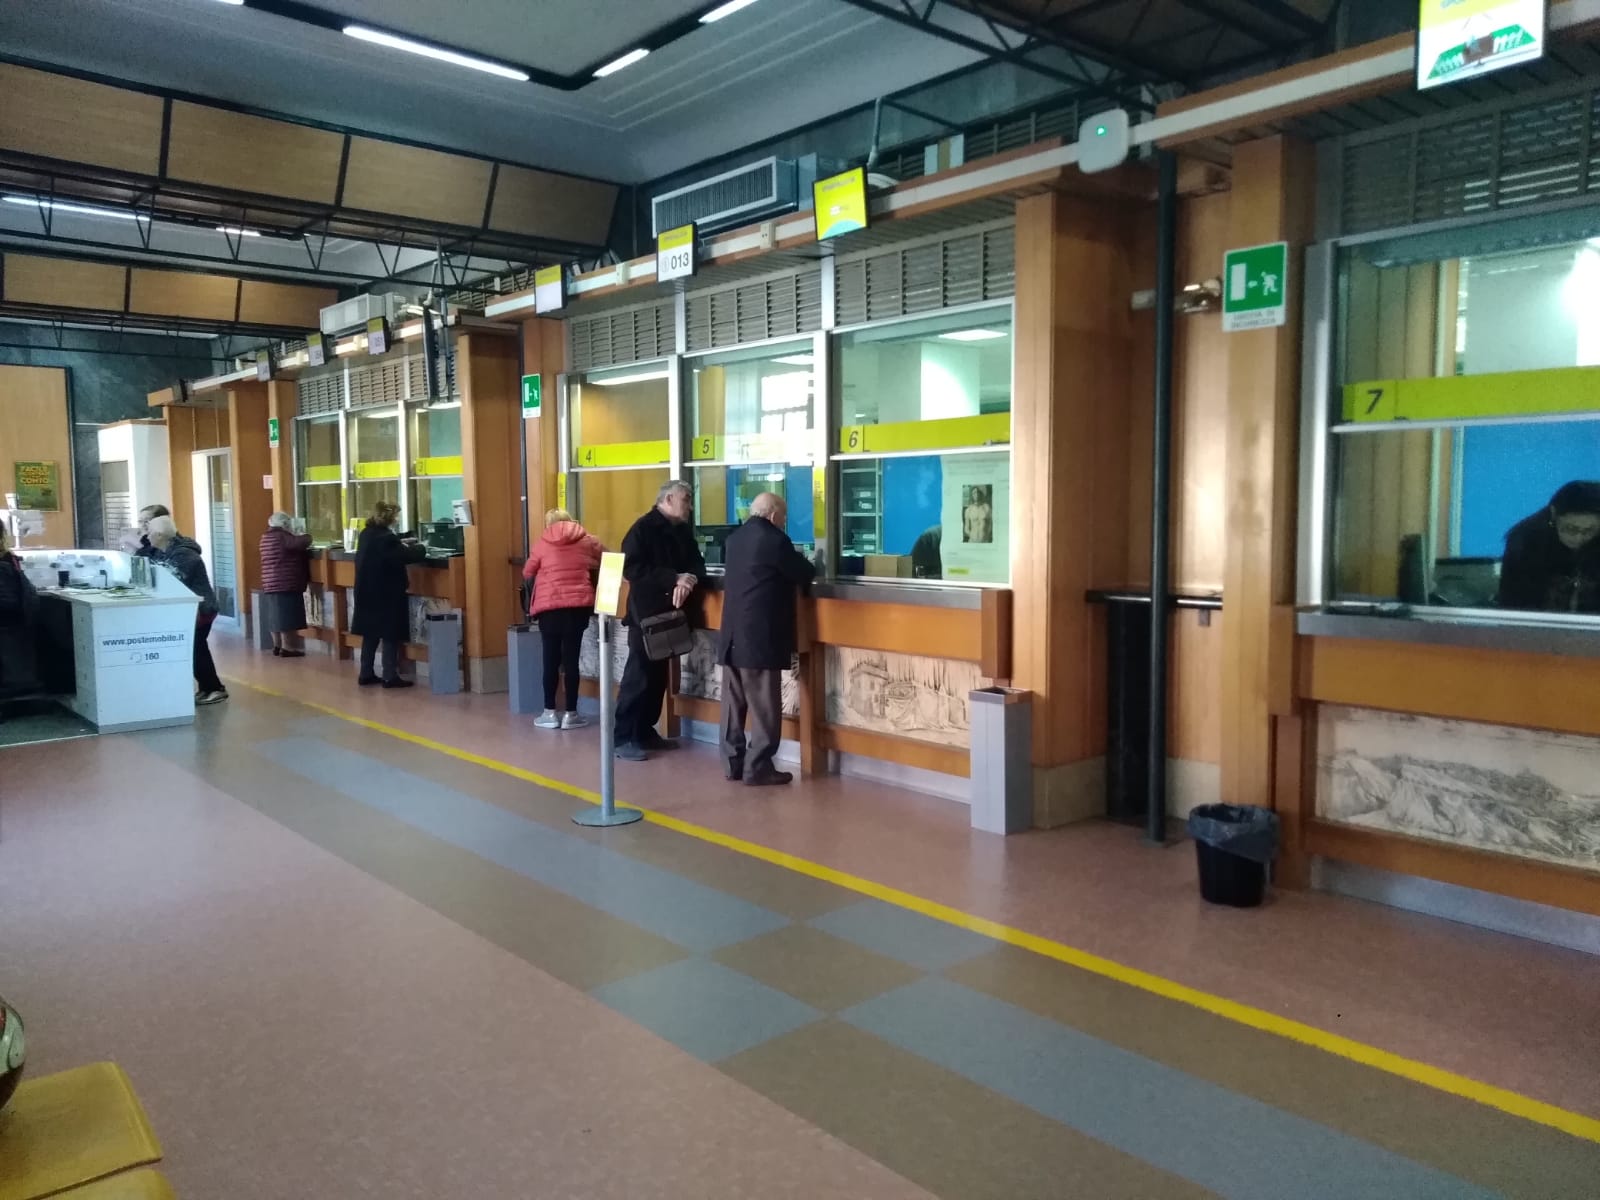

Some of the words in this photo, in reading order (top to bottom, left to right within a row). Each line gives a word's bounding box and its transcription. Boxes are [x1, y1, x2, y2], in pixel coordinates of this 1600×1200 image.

[671, 252, 689, 270] 013
[1365, 388, 1384, 415] 7
[702, 439, 710, 454] 5
[849, 430, 859, 448] 6
[585, 449, 592, 463] 4
[102, 633, 184, 646] www.postemobile.it
[145, 652, 159, 661] 160
